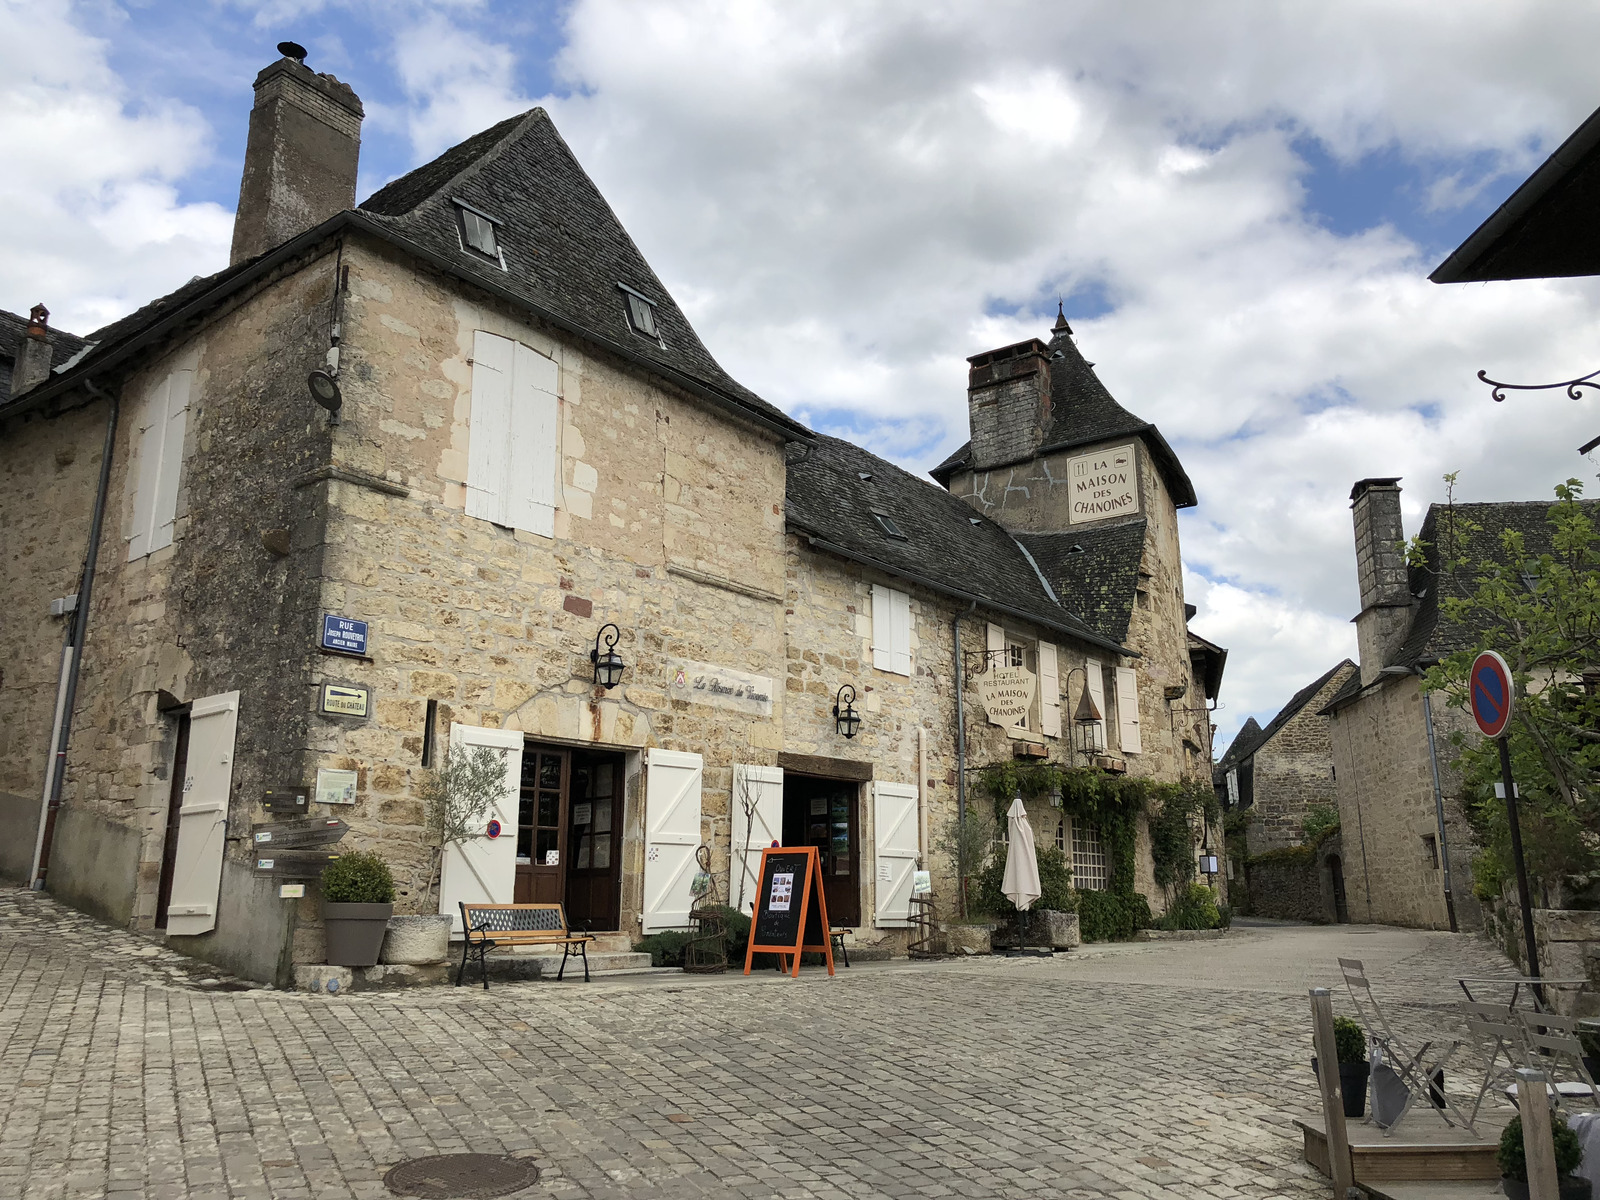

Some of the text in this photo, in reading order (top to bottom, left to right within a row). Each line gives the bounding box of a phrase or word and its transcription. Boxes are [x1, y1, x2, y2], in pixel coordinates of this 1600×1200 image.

[1094, 460, 1108, 470] LA
[1076, 473, 1127, 493] MAISON
[1093, 488, 1112, 499] DES
[1074, 491, 1133, 514] CHANOINES
[339, 620, 354, 631] RUE
[993, 671, 1019, 680] HOTEL
[983, 678, 1030, 687] RESTAURANT
[985, 689, 1029, 702] LA MAISON
[326, 698, 340, 708] ROUTE
[989, 704, 1026, 717] CHANOINES
